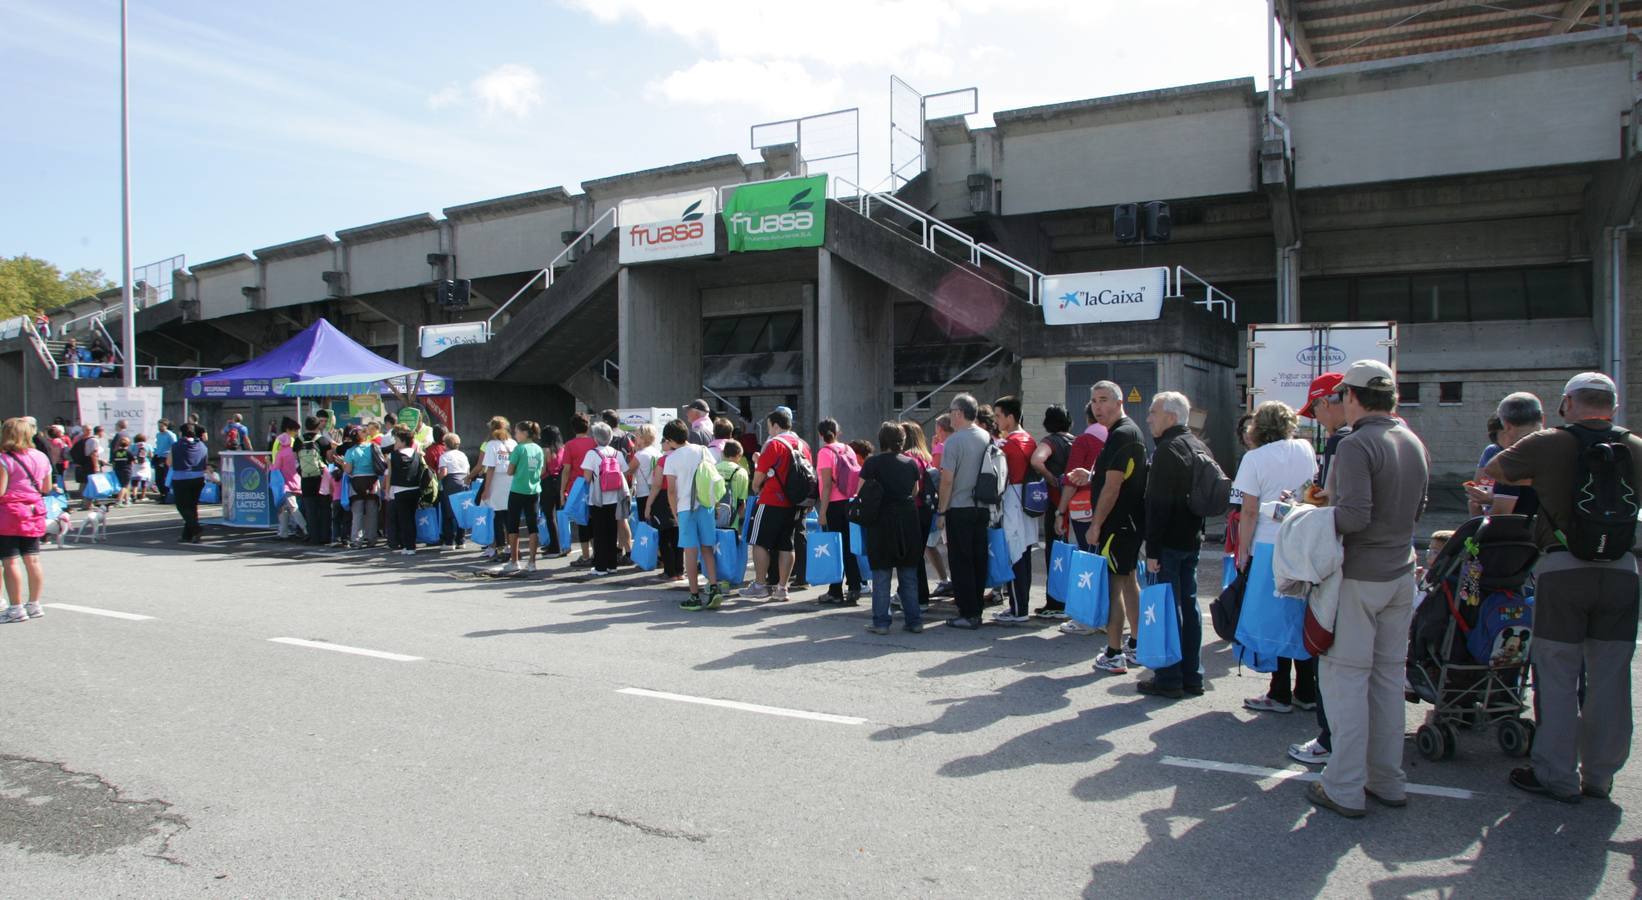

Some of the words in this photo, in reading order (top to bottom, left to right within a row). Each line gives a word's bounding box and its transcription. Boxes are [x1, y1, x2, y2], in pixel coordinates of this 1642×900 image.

[730, 211, 813, 235] fruasa
[629, 221, 704, 247] fruasa
[1079, 286, 1146, 307] "laCaixa"
[113, 407, 143, 418] aecc
[236, 491, 266, 500] BEBIDAS
